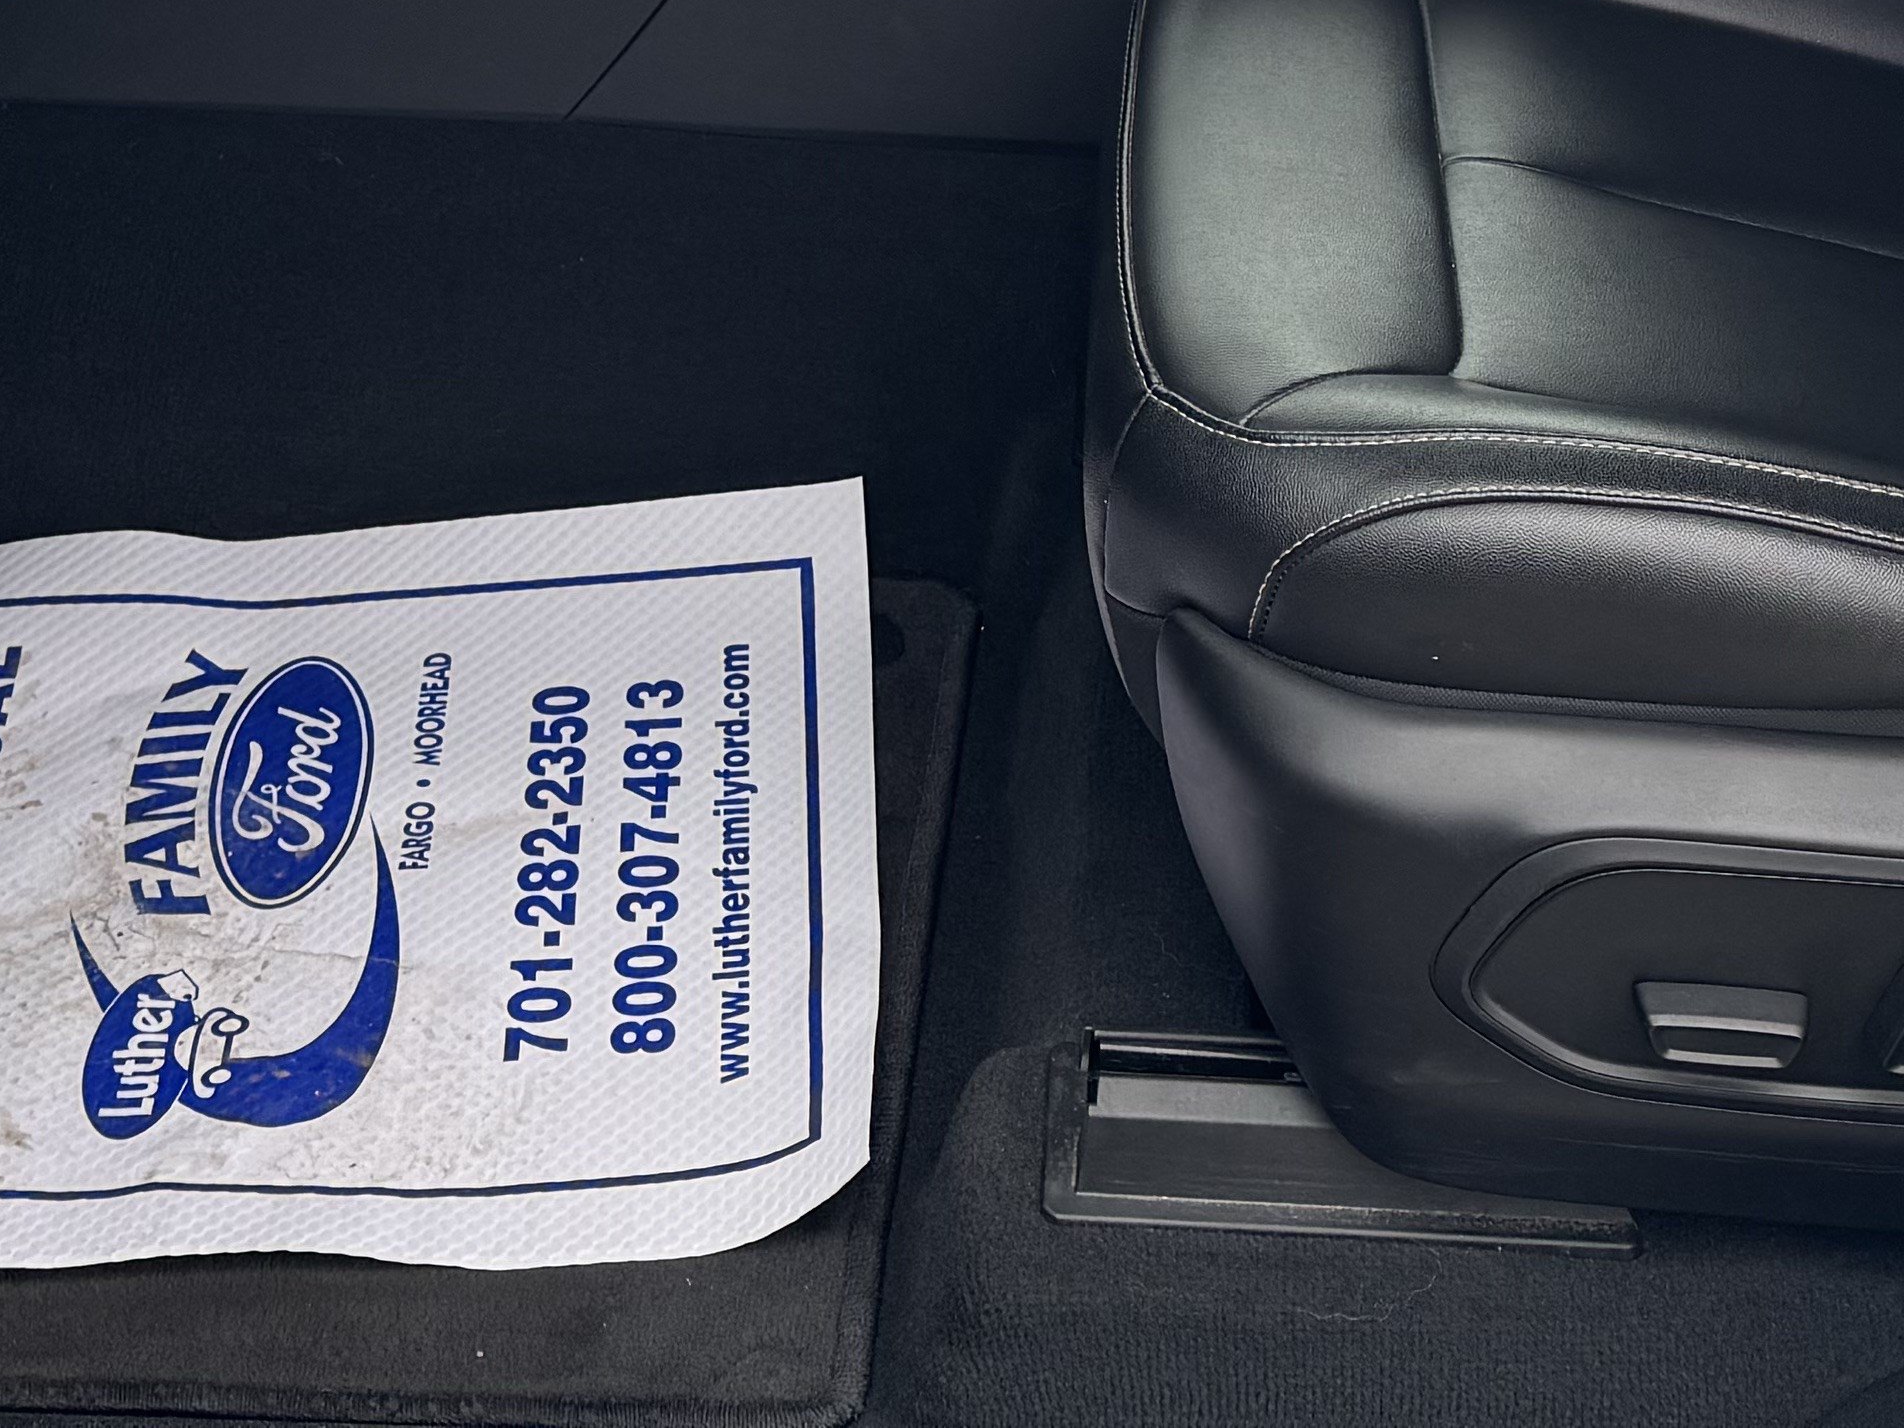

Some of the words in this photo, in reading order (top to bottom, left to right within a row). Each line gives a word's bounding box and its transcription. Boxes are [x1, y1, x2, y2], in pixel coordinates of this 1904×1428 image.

[123, 648, 249, 916] FAMILY
[232, 706, 343, 853] Ford
[414, 652, 453, 767] MOORHEAD
[398, 801, 436, 871] FARGO
[504, 685, 592, 1062] 701-282-2350
[610, 679, 685, 1055] 800-307-4813
[712, 643, 758, 1083] www.lutherfamilyford.com
[98, 994, 180, 1117] Luther
